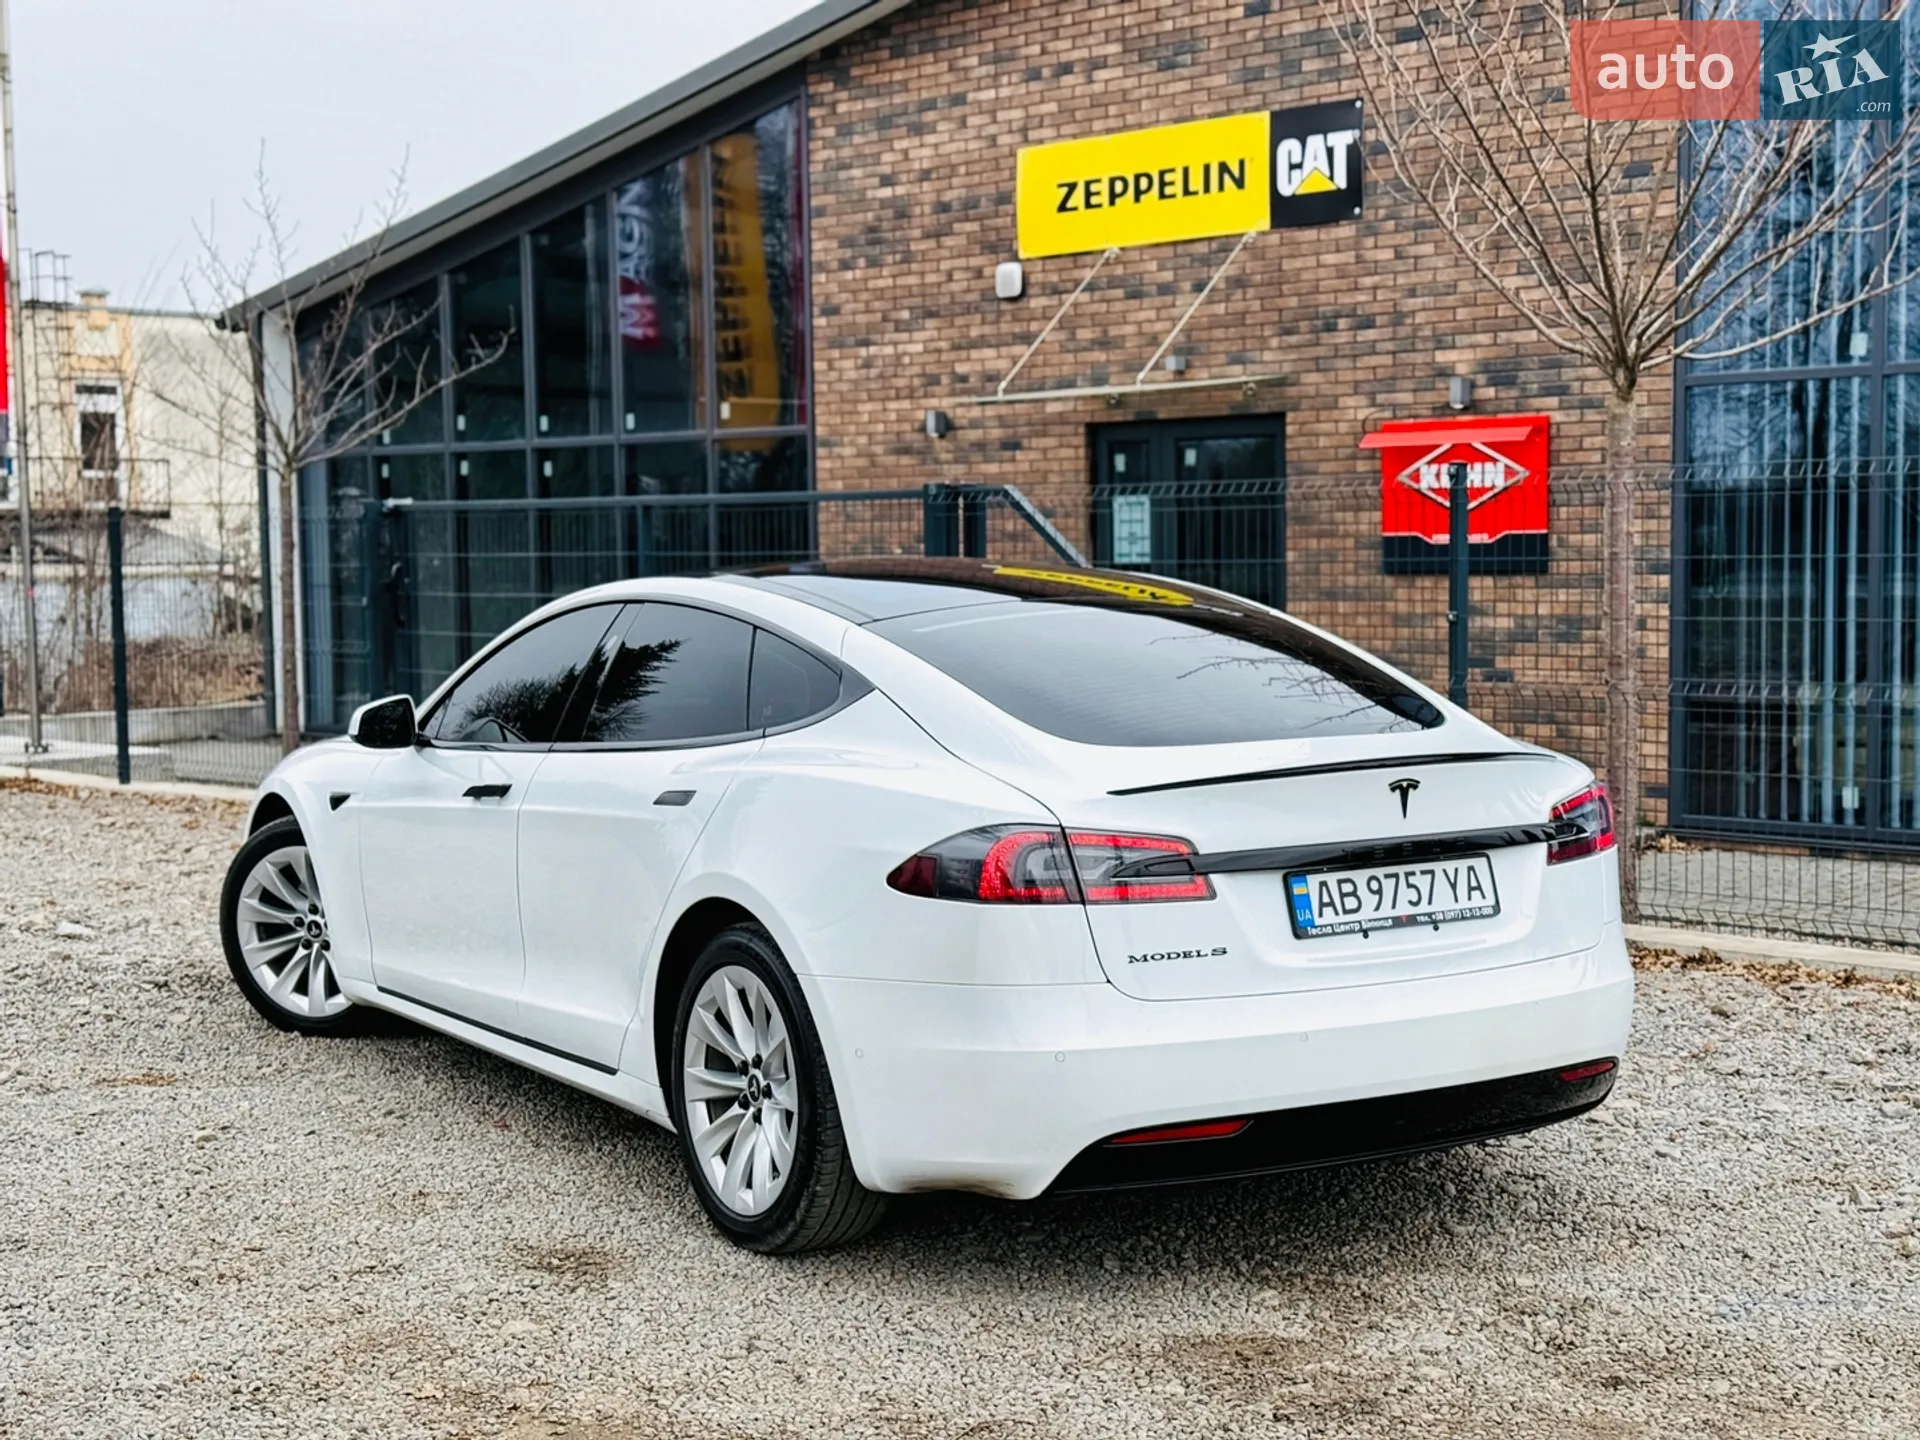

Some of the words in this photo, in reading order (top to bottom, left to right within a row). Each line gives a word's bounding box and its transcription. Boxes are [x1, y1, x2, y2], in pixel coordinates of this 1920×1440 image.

[1056, 159, 1247, 213] ZEPPELIN
[1276, 130, 1356, 197] CAT
[1318, 878, 1362, 918] AB
[1366, 869, 1436, 912] 9757
[1442, 865, 1487, 903] YA
[1297, 909, 1312, 921] UA
[1127, 949, 1208, 964] MODEL
[1210, 946, 1228, 956] S
